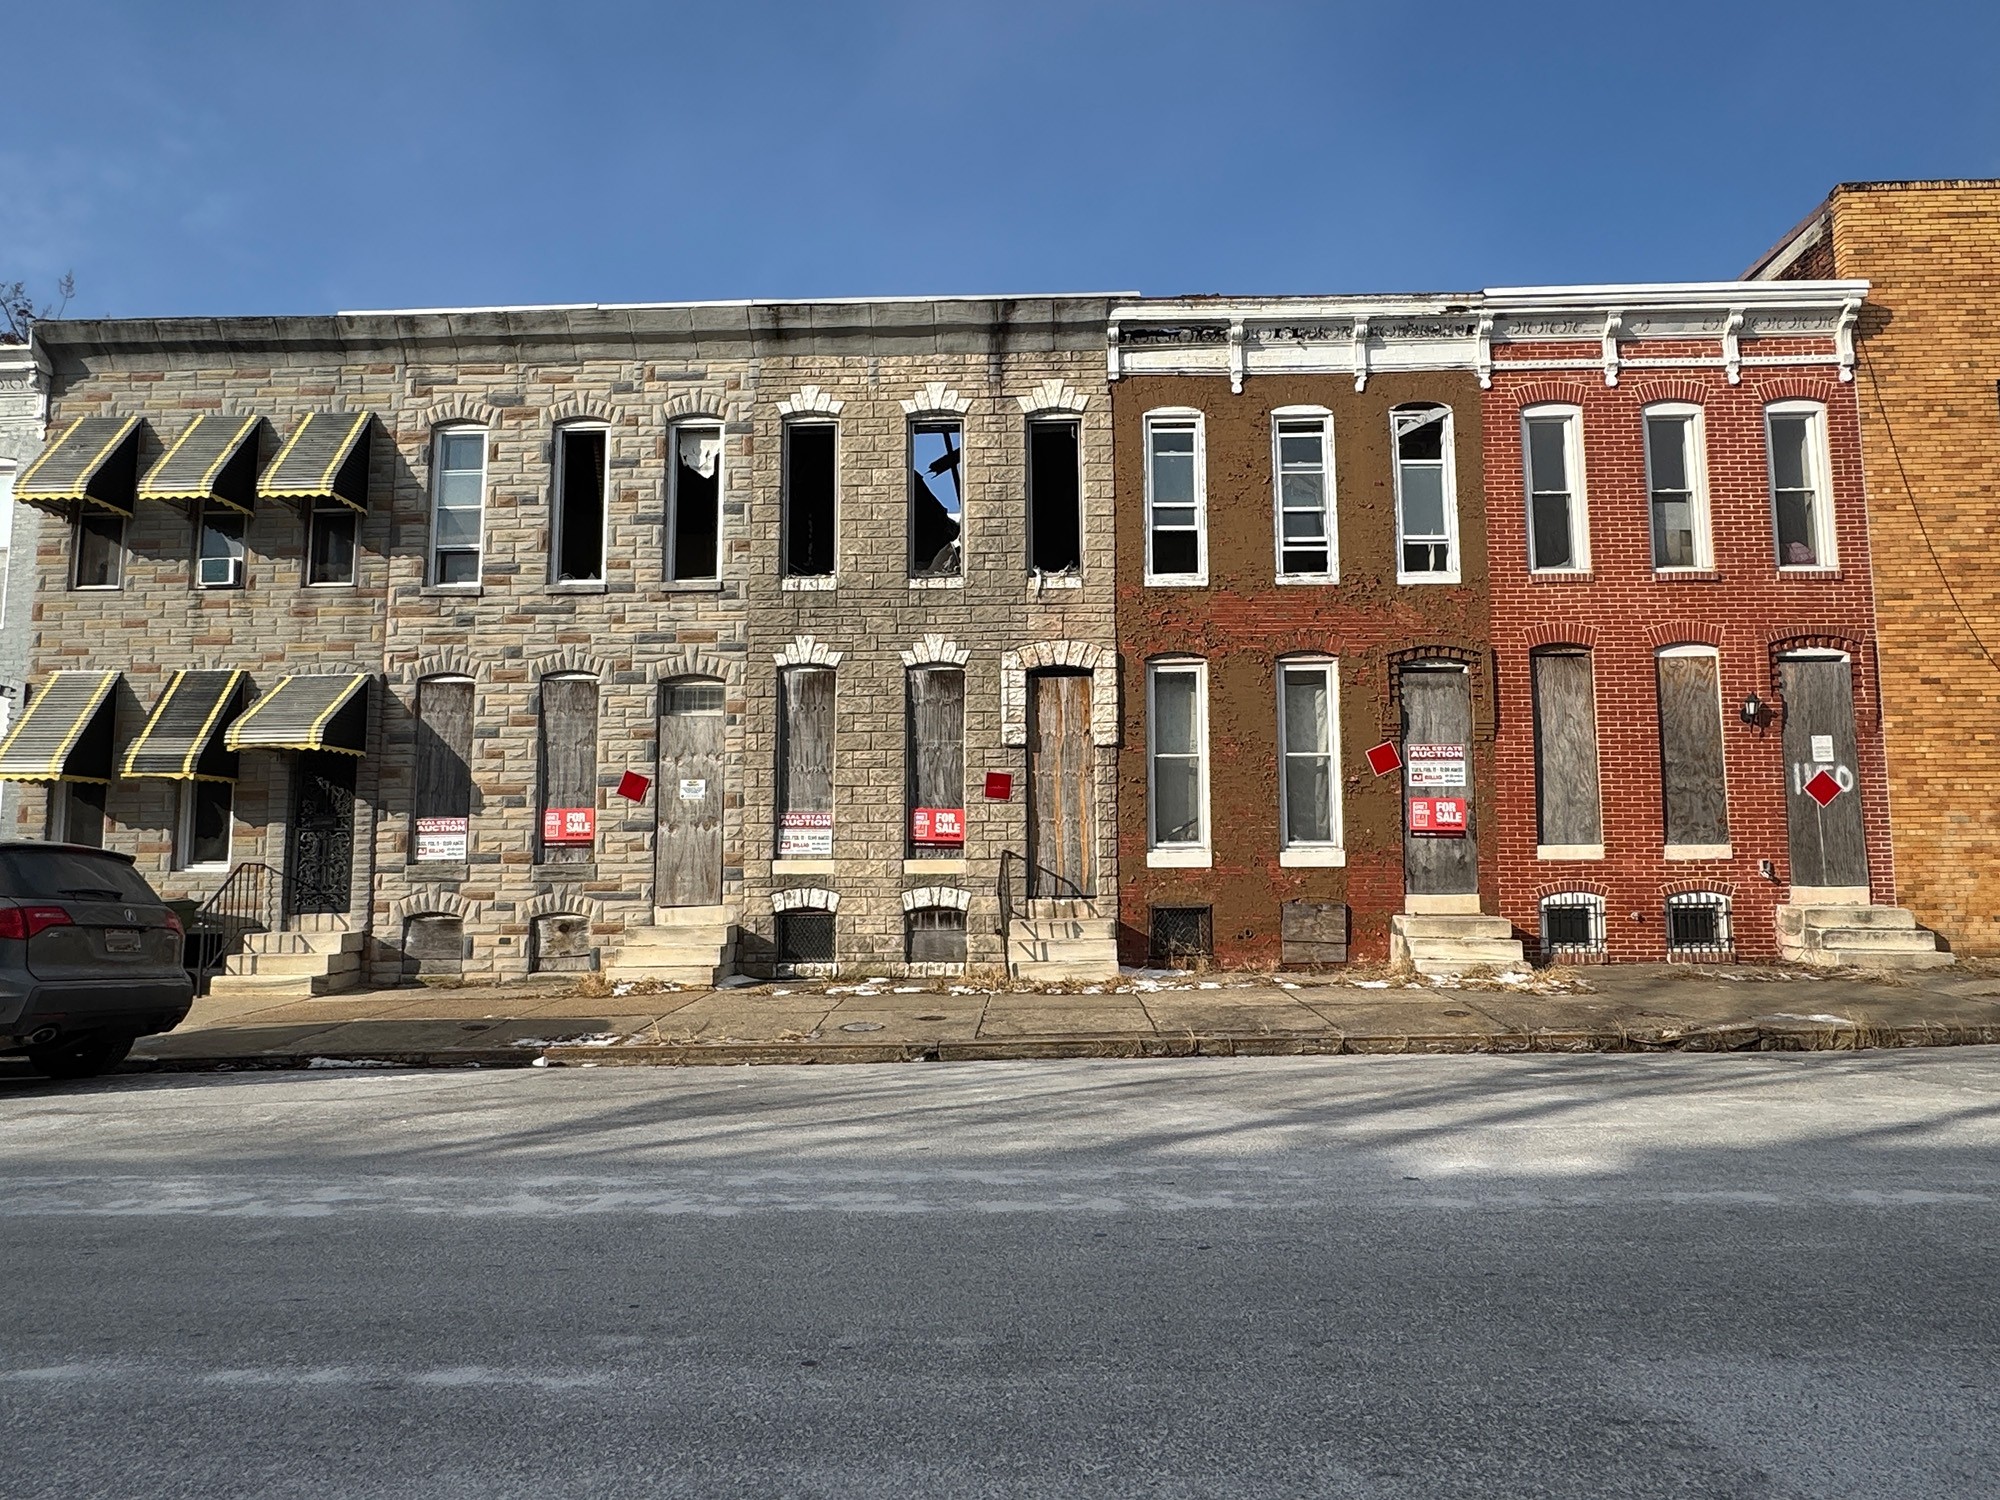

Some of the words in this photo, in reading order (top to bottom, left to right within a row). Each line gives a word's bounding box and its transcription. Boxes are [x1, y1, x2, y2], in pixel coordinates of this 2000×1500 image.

[1436, 801, 1456, 812] FOR
[566, 812, 586, 822] FOR
[935, 812, 955, 823] FOR
[1436, 812, 1463, 823] SALE
[566, 822, 591, 833] SALE
[935, 822, 961, 833] SALE
